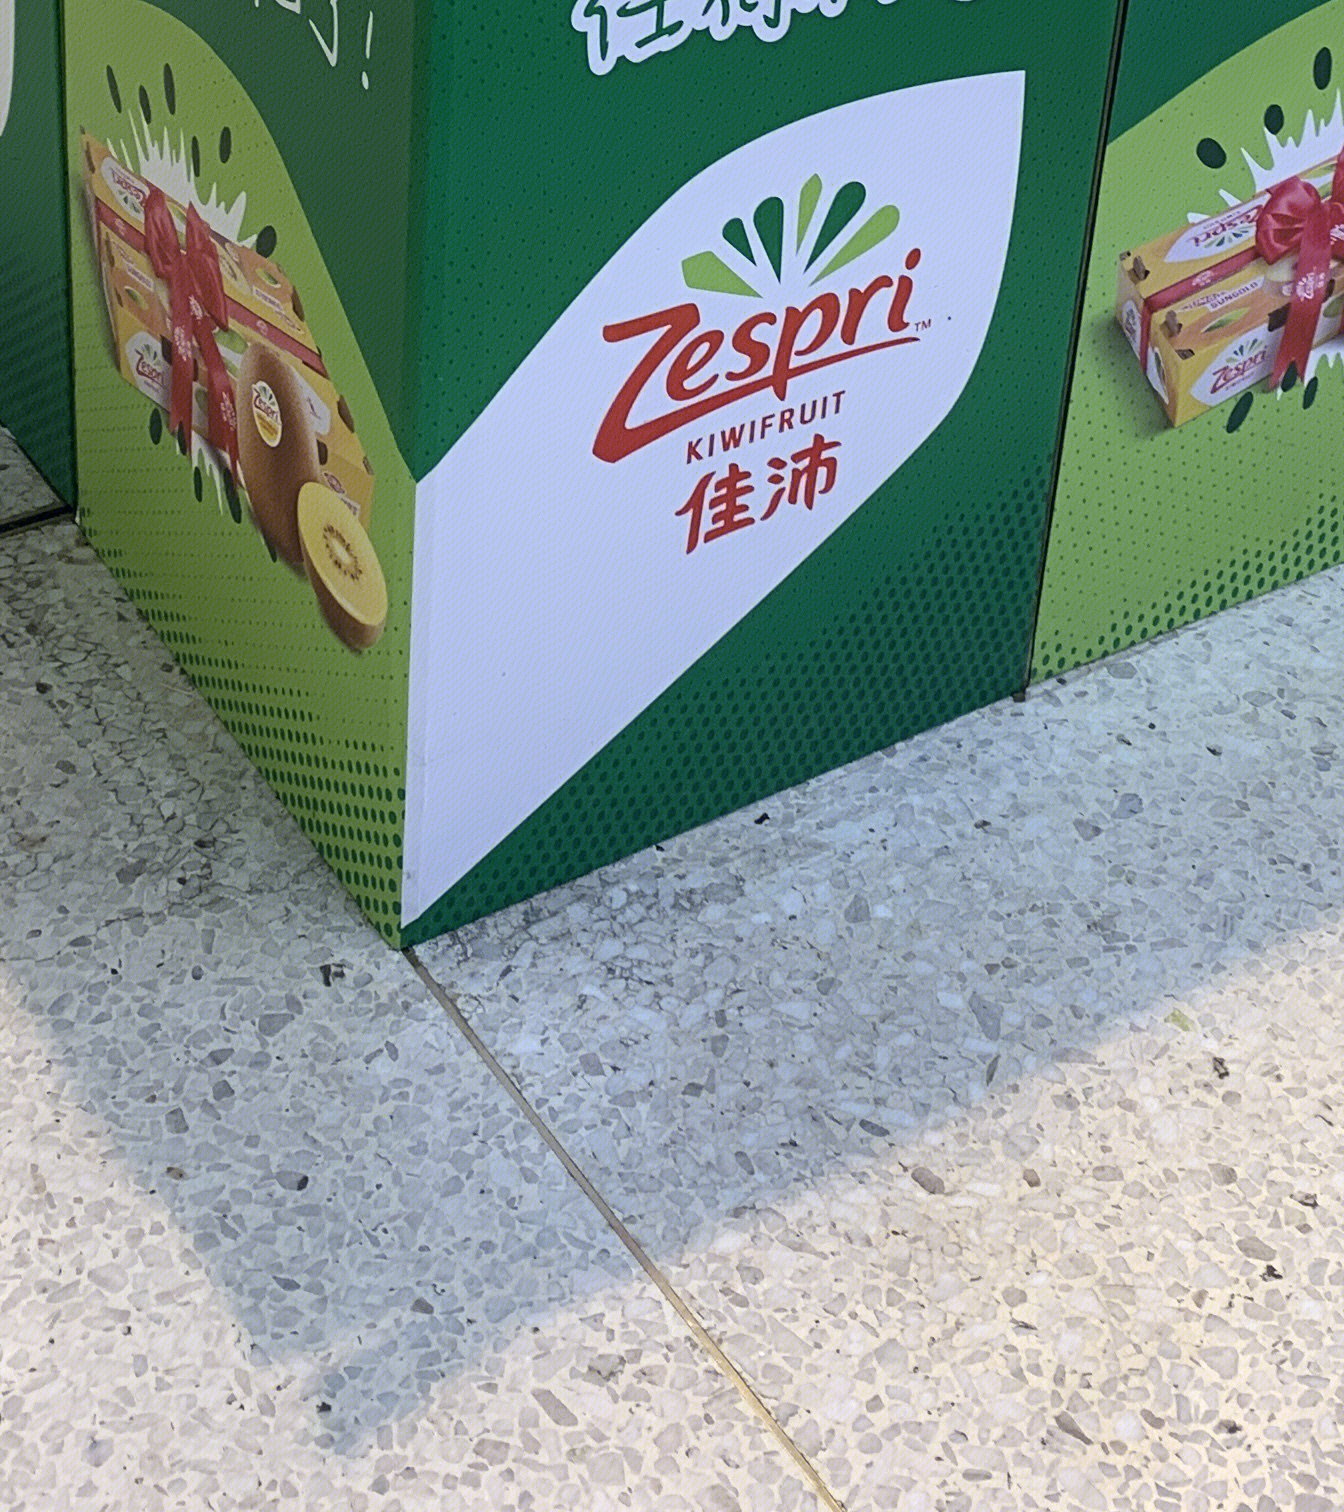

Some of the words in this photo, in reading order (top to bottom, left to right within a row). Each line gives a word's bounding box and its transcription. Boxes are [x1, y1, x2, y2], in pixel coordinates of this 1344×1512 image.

[593, 247, 922, 464] Zespri
[1210, 346, 1267, 394] Zespri
[686, 390, 846, 464] KIWIFRUIT
[675, 433, 842, 555] 佳沛
